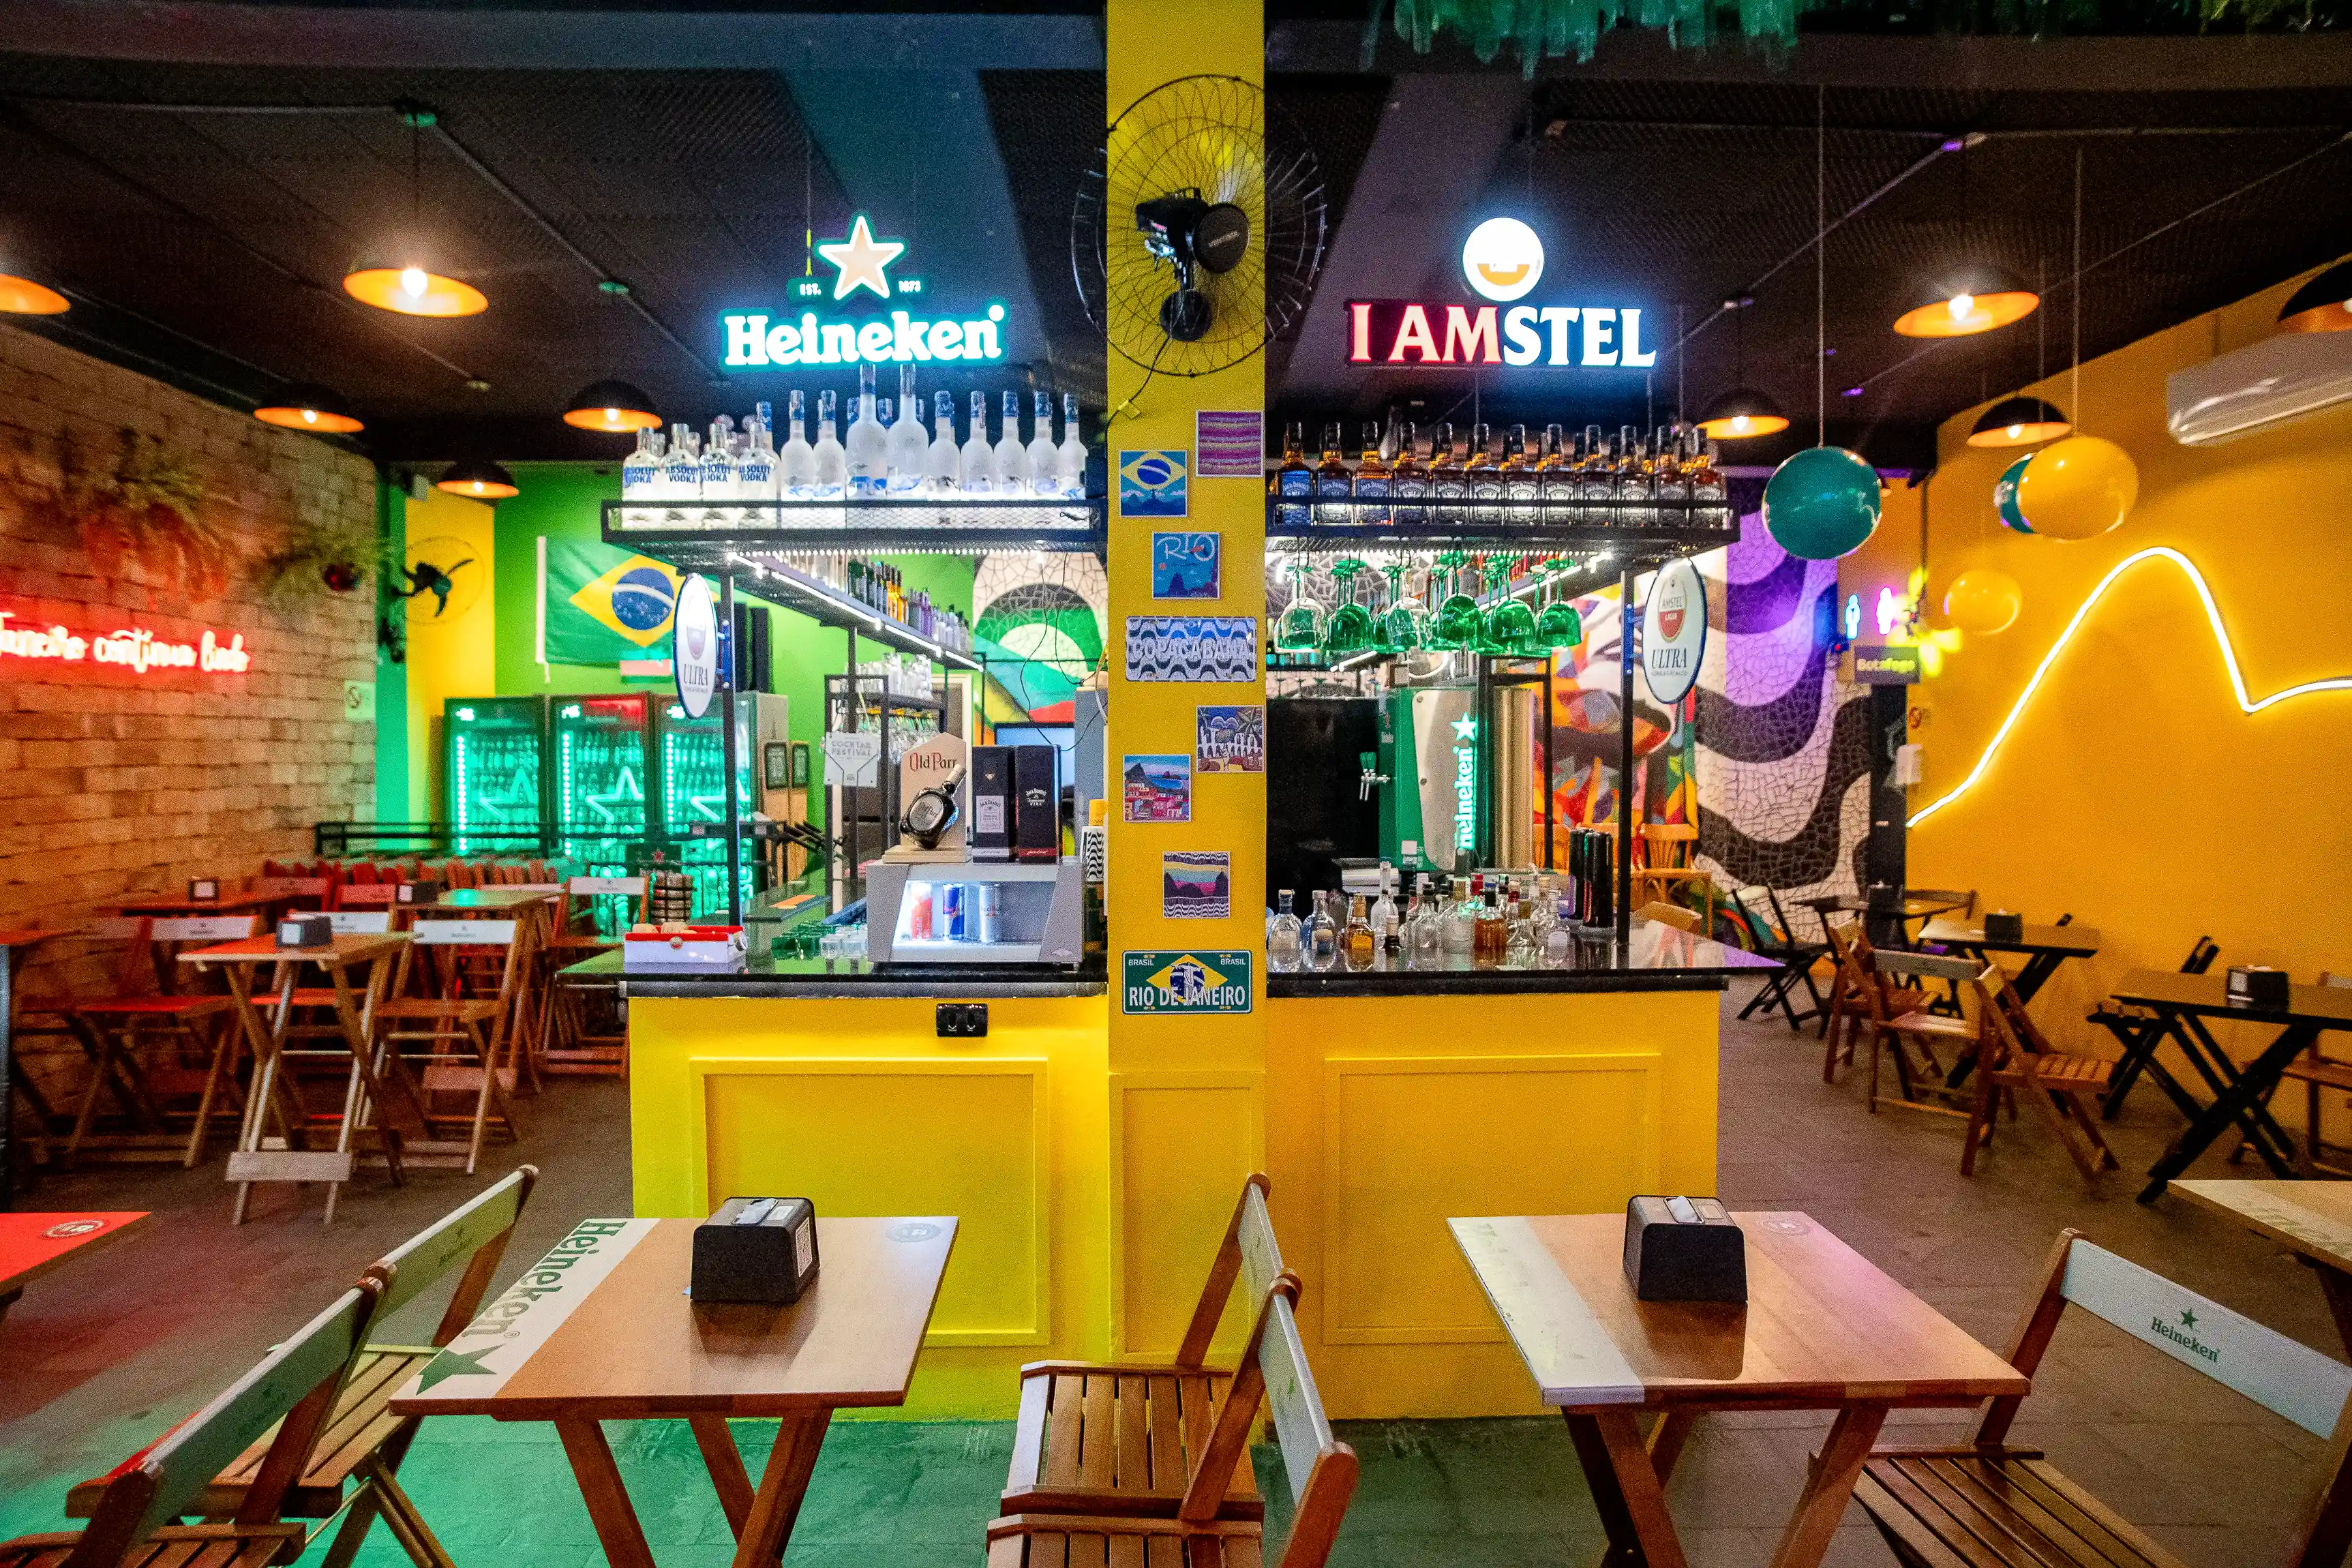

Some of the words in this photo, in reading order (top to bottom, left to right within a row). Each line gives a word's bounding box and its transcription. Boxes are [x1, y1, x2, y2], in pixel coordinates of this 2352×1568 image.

[724, 310, 1002, 365] Heineken
[1350, 303, 1372, 362] I
[1387, 304, 1657, 367] AMSTEL
[1156, 534, 1215, 562] RIO
[1132, 637, 1250, 660] COPACABANA
[1651, 648, 1687, 669] ULTRA
[683, 663, 709, 686] ULTRA
[909, 752, 930, 772] Old
[932, 752, 957, 771] Parr
[1220, 958, 1246, 966] BRASIL
[1129, 986, 1154, 1007] RIO
[1160, 986, 1179, 1006] DE
[1183, 986, 1246, 1007] JANEIRO
[461, 1221, 629, 1338] Heineken
[2150, 1316, 2221, 1363] Heineken
